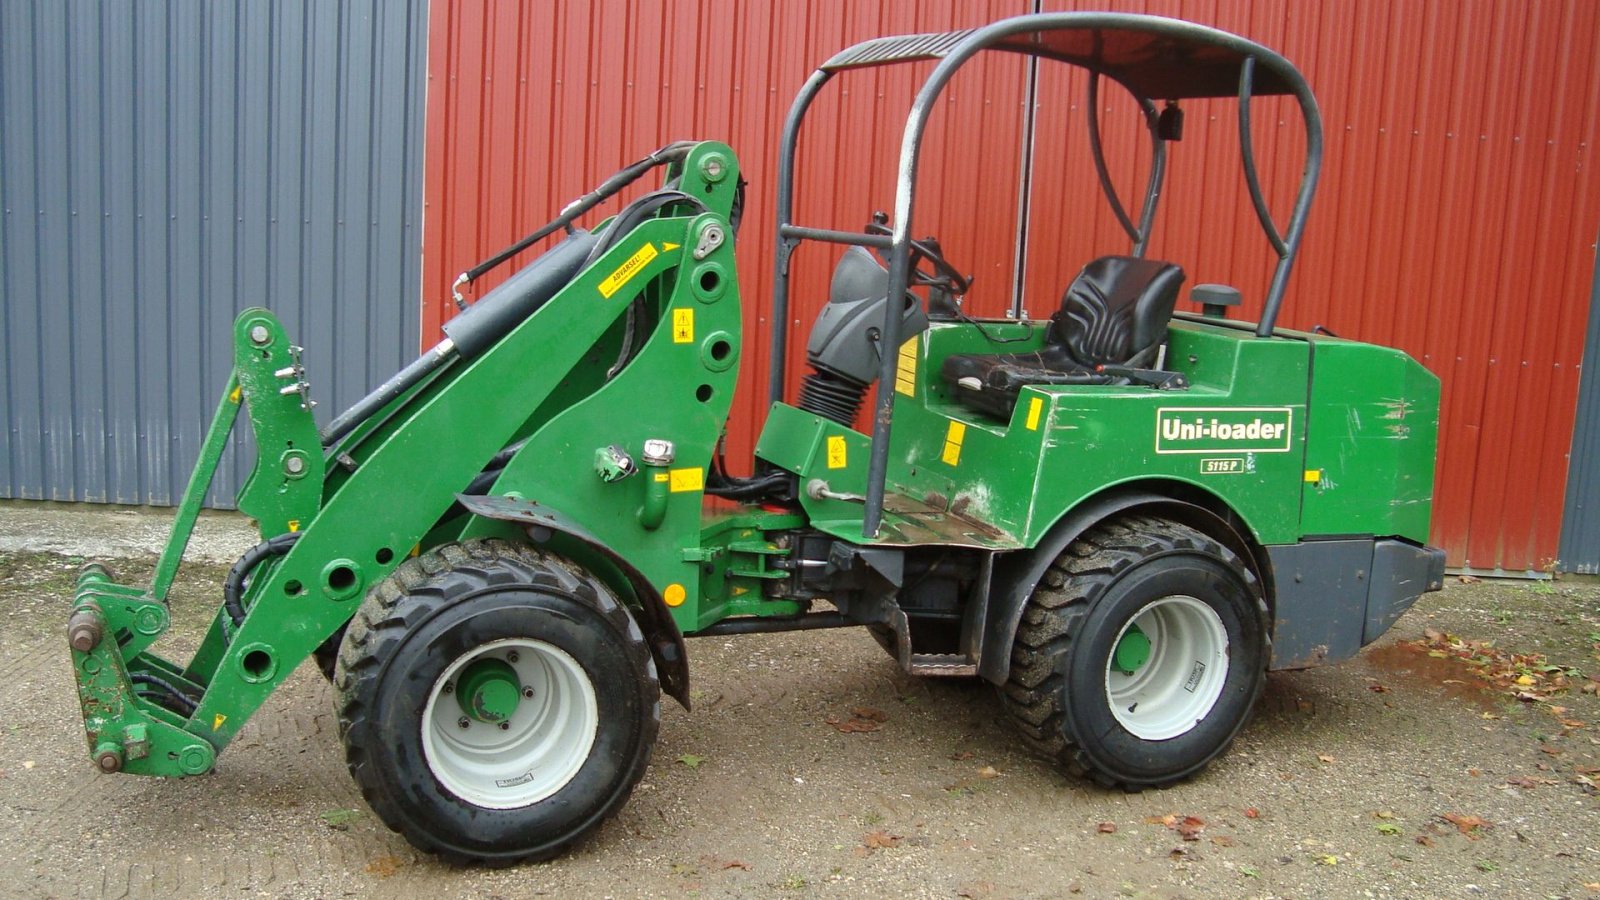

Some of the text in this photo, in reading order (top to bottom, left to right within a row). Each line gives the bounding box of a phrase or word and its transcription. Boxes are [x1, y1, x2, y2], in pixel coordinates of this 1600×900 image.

[612, 254, 642, 283] ADVARSEL!
[1207, 460, 1238, 471] 5115 P
